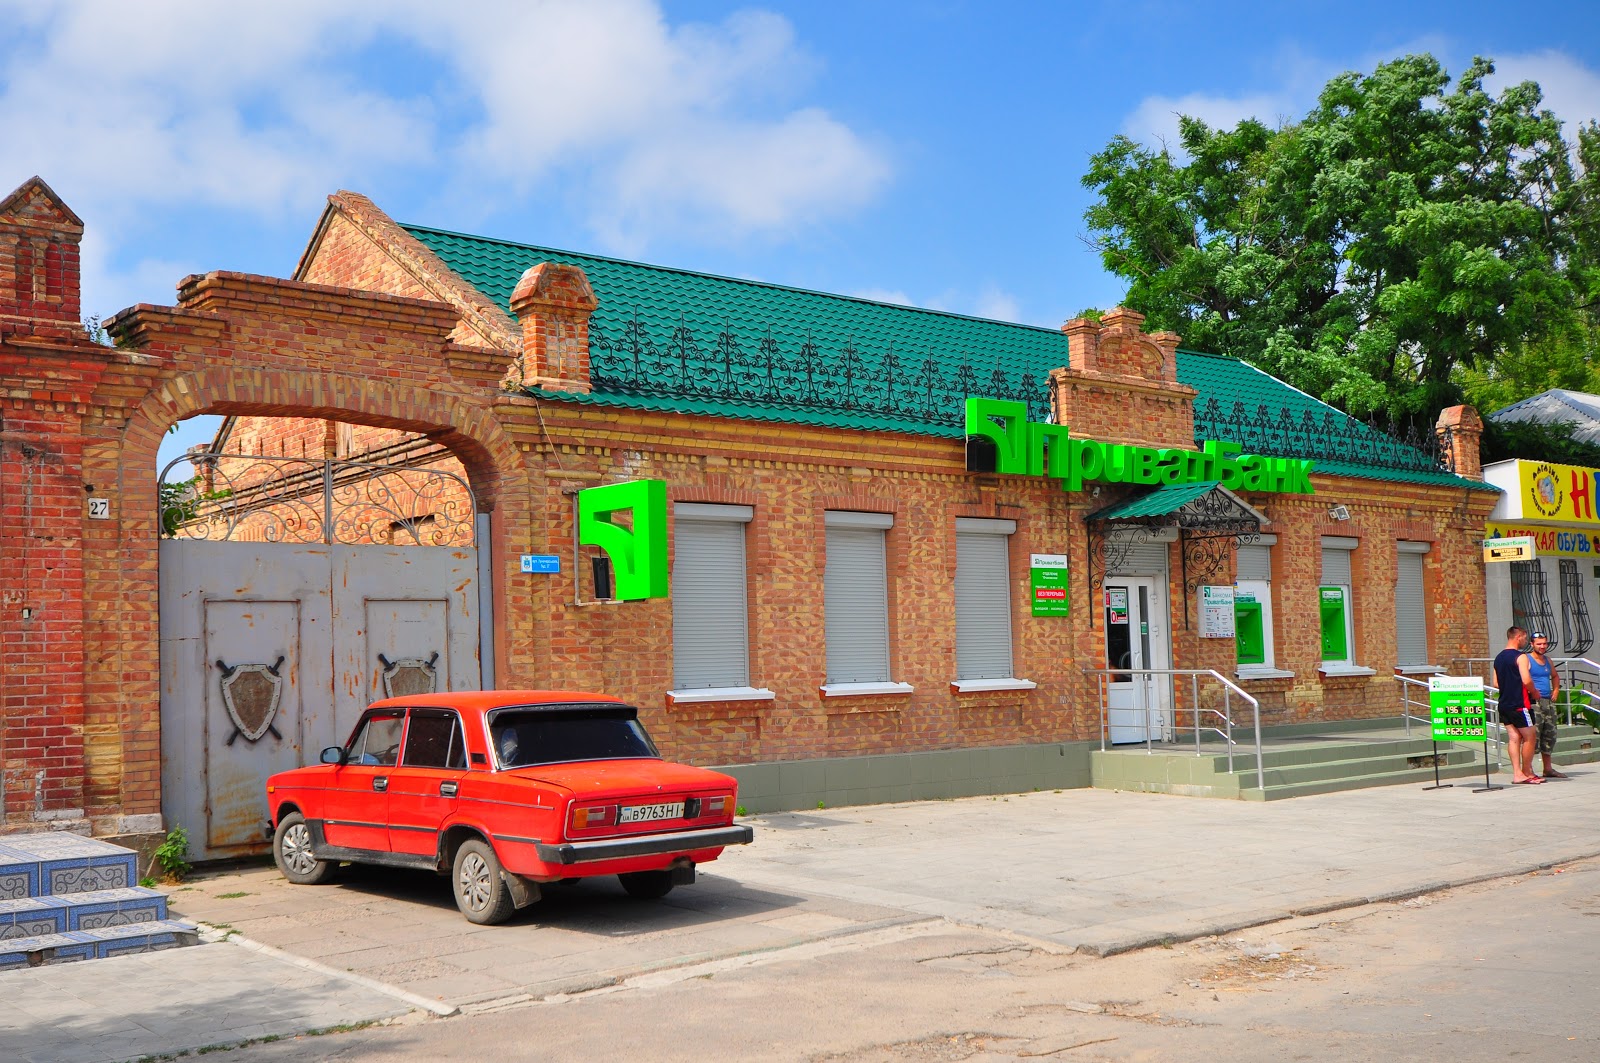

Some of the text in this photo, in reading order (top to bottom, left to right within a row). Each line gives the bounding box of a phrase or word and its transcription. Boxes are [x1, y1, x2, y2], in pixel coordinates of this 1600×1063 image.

[1026, 422, 1315, 495] ПриватБанк
[90, 501, 107, 515] 27
[1570, 470, 1600, 520] Н
[1558, 533, 1590, 552] ОБУВЬ
